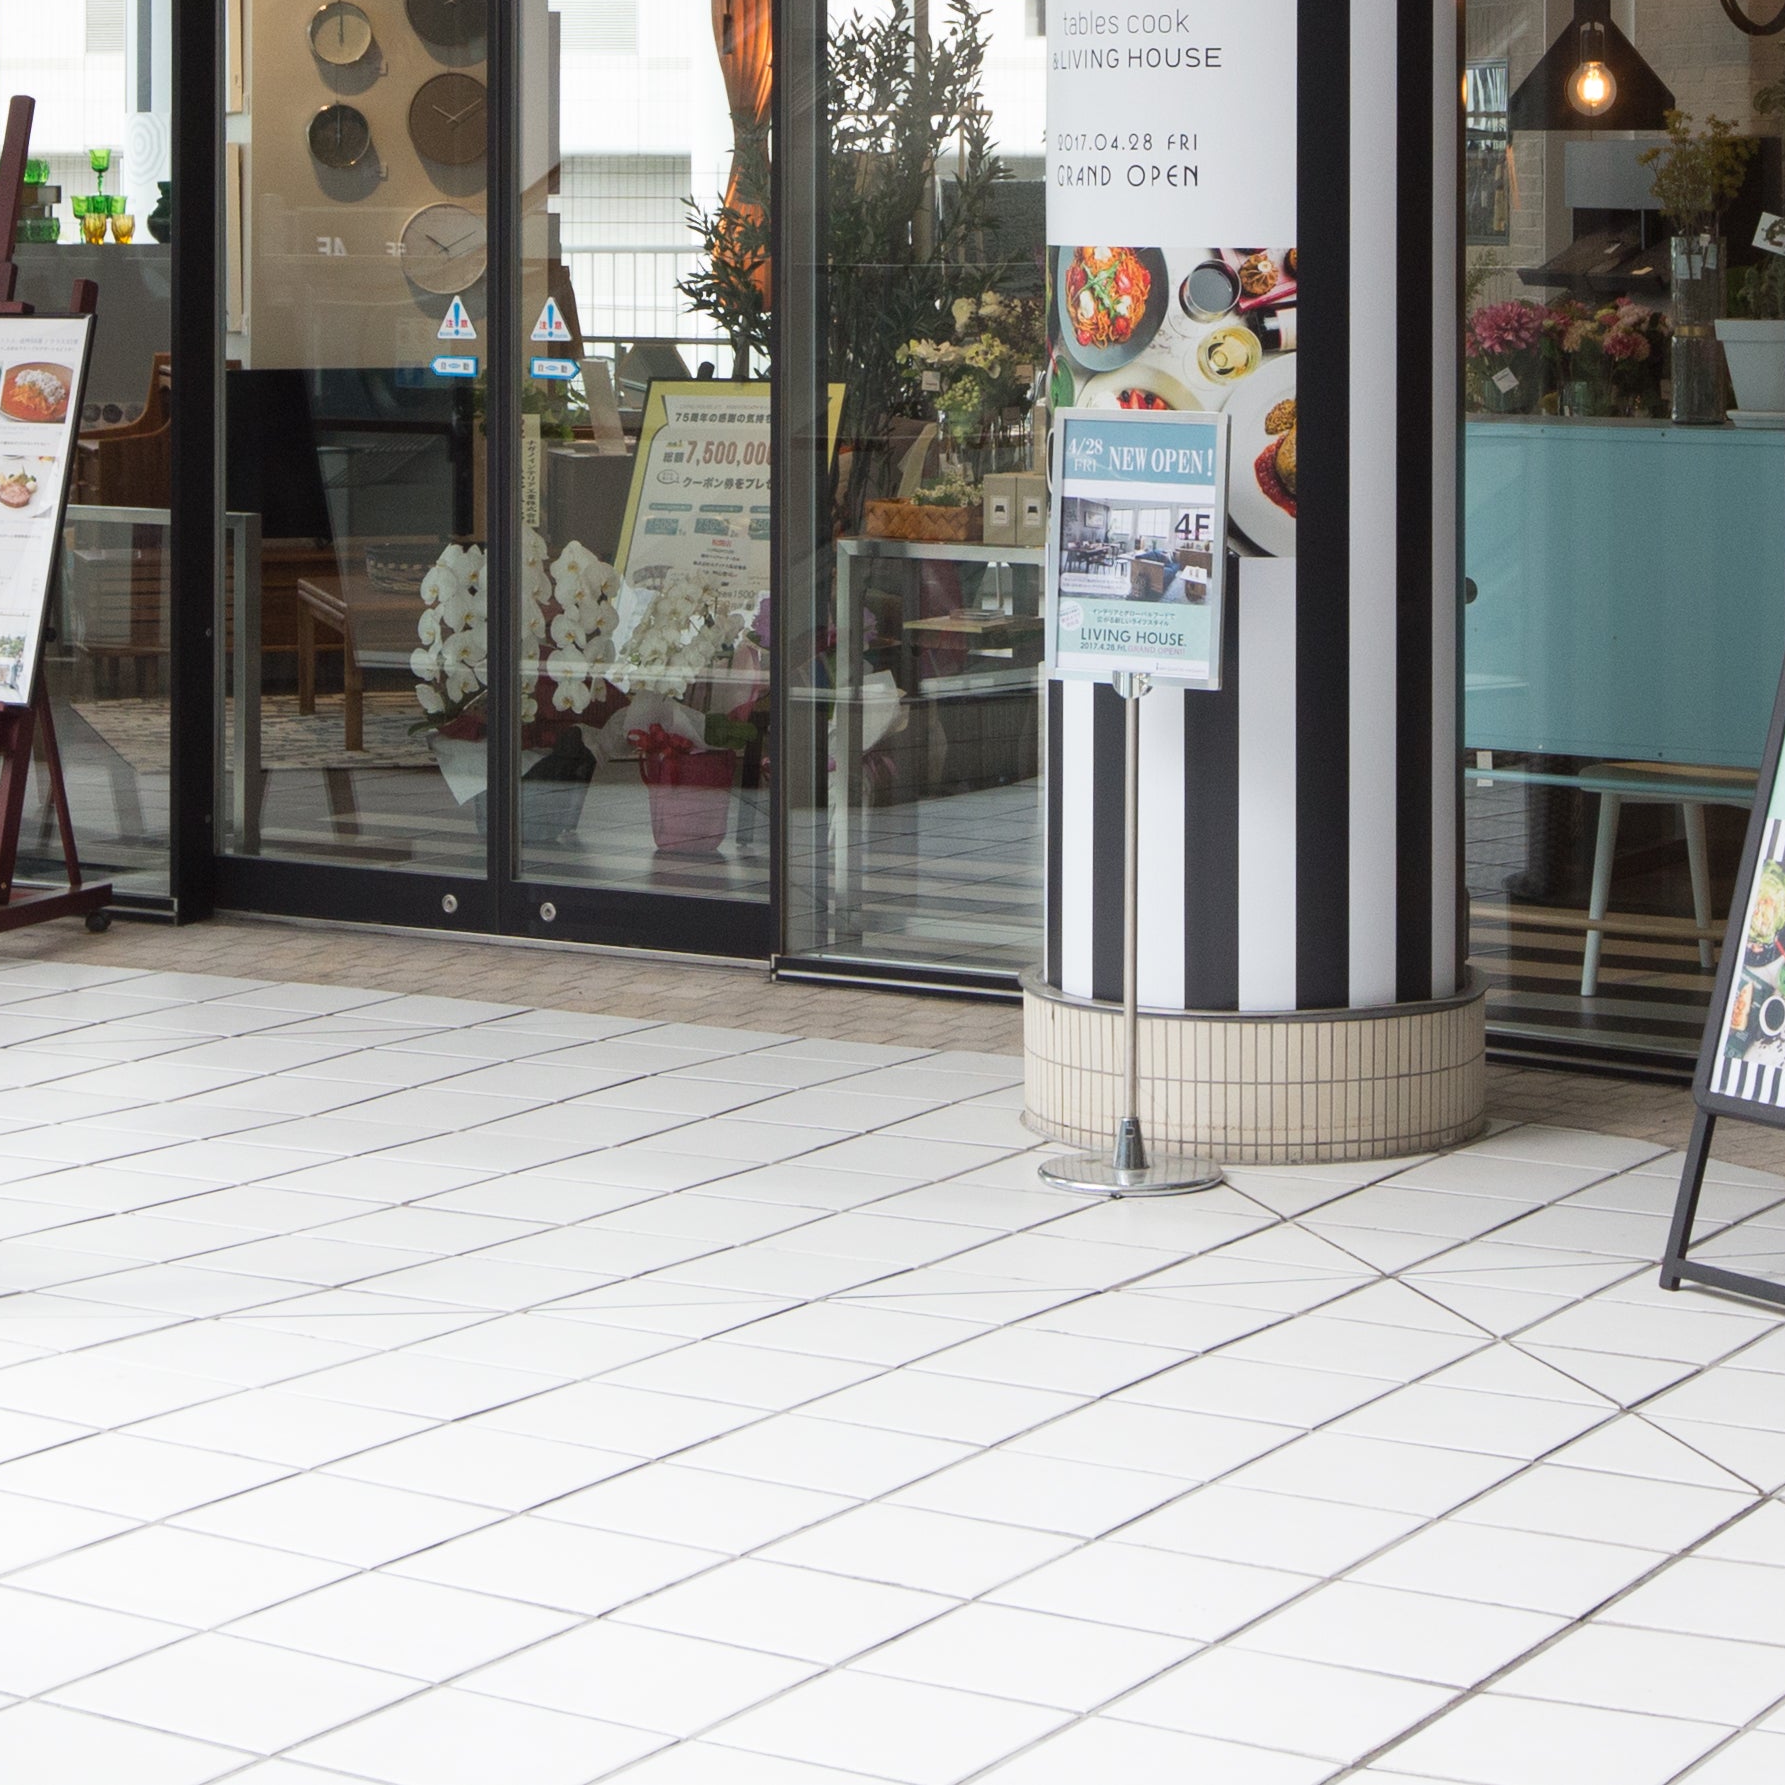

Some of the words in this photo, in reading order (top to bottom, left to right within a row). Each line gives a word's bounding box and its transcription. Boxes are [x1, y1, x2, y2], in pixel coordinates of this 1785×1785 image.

[1063, 10, 1119, 36] tables
[1127, 9, 1190, 34] cook
[1128, 47, 1222, 68] HOUSE
[1057, 133, 1153, 151] 2017.04.28
[1167, 133, 1197, 151] FRI
[1057, 165, 1112, 187] GRAND
[1127, 165, 1198, 187] OPEN
[1068, 437, 1104, 456] 4/28
[1074, 458, 1097, 473] FRI
[1108, 446, 1148, 472] NEW
[1174, 513, 1211, 541] 4F
[1081, 628, 1131, 643] LIVING
